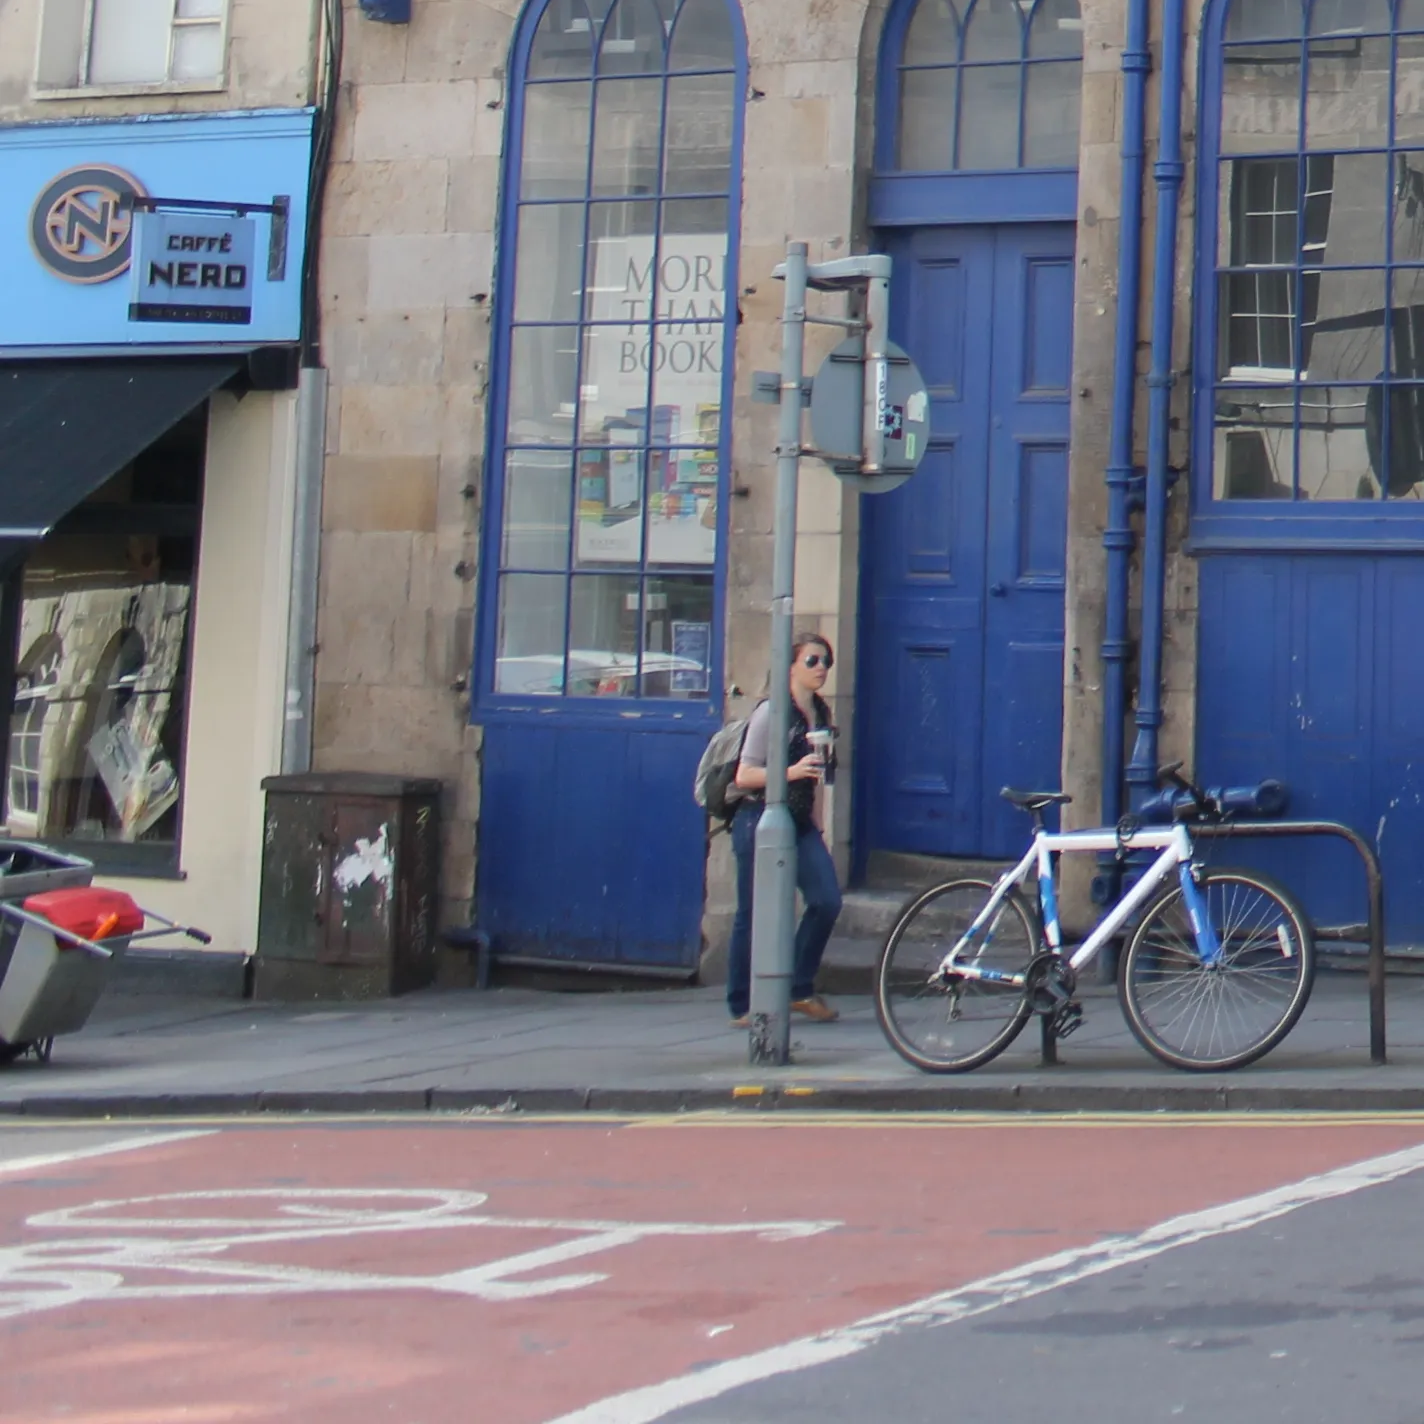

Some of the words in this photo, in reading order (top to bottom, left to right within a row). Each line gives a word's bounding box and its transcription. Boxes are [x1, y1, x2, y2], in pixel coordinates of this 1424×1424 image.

[149, 262, 248, 289] NERO
[622, 254, 726, 293] MOR
[619, 340, 722, 374] BOOK
